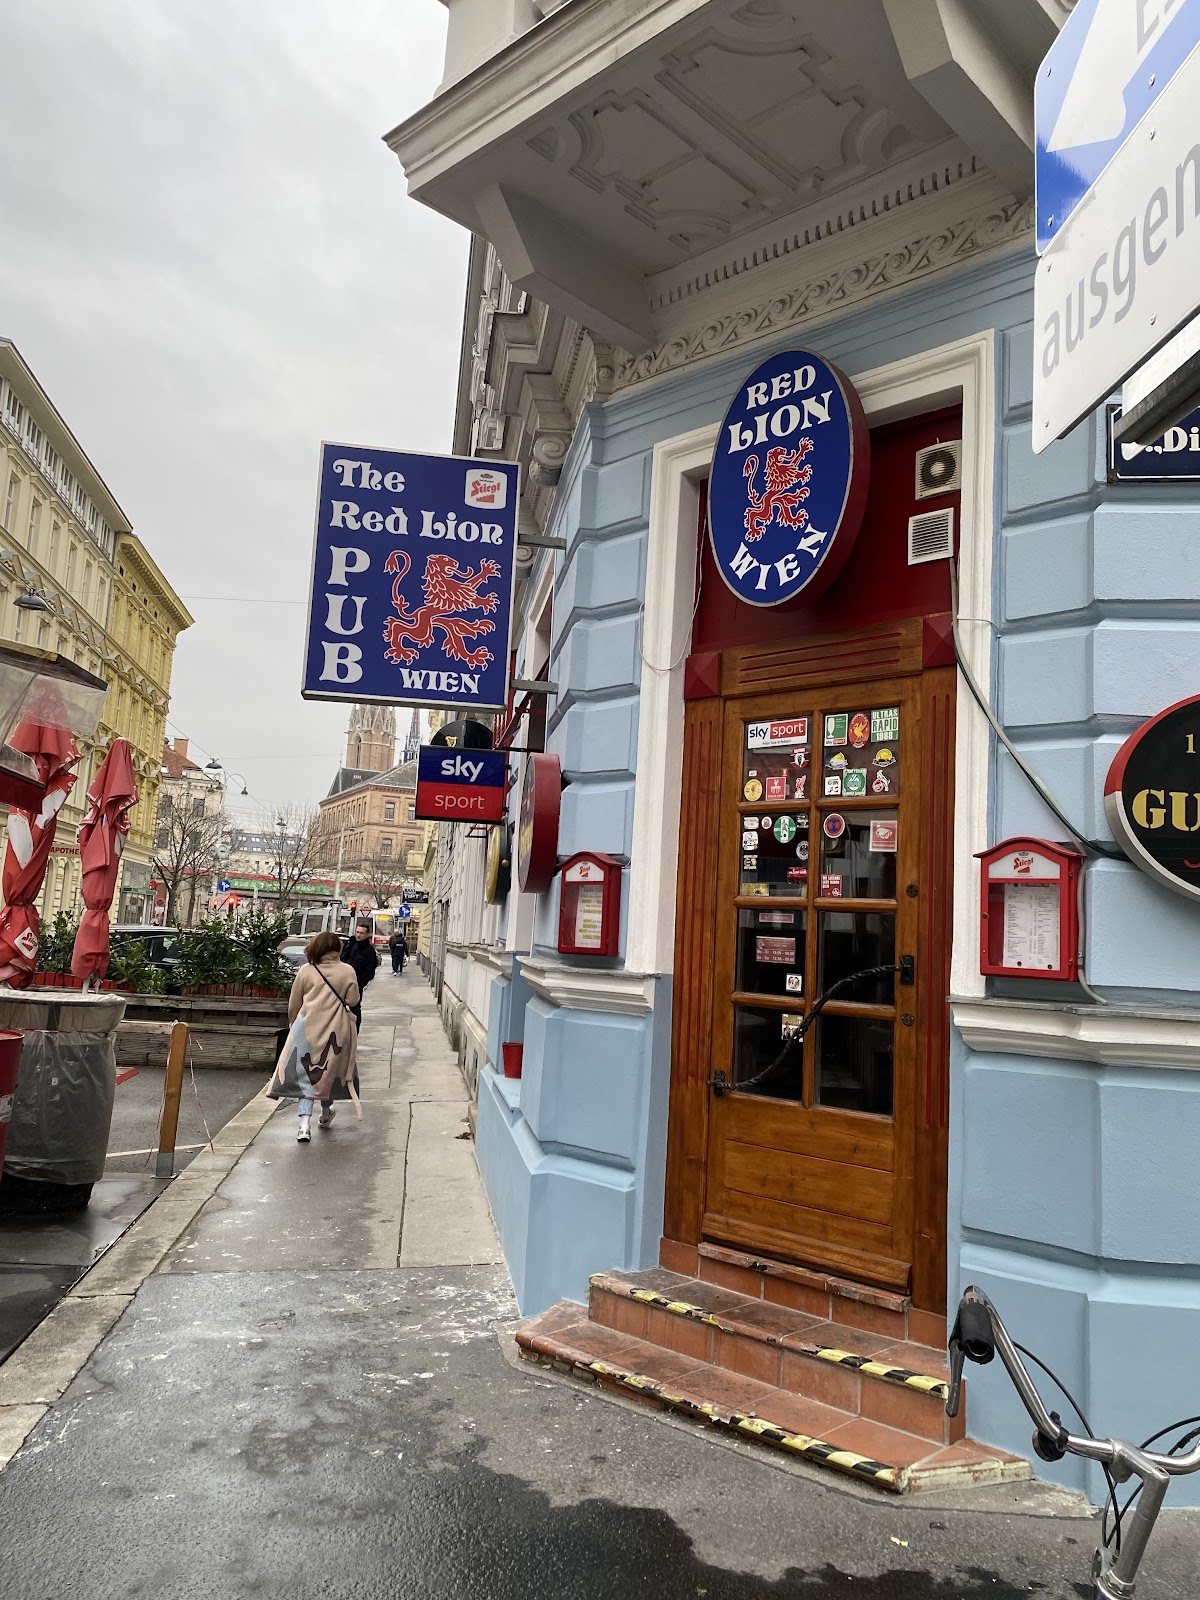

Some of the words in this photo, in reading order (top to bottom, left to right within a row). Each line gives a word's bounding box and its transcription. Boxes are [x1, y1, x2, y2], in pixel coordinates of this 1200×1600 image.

[746, 364, 817, 411] RED
[727, 390, 834, 455] LION
[332, 459, 406, 493] The
[470, 480, 501, 497] Stiegl
[329, 499, 409, 536] Red
[419, 509, 504, 546] Lion
[728, 522, 828, 591] WIEN
[319, 545, 371, 684] PUB
[399, 667, 481, 694] WIEN
[872, 709, 898, 719] ULTRAS
[872, 718, 897, 732] RAPID
[749, 726, 769, 739] sky
[772, 723, 804, 737] sport
[440, 754, 484, 783] sky
[434, 793, 485, 811] sport
